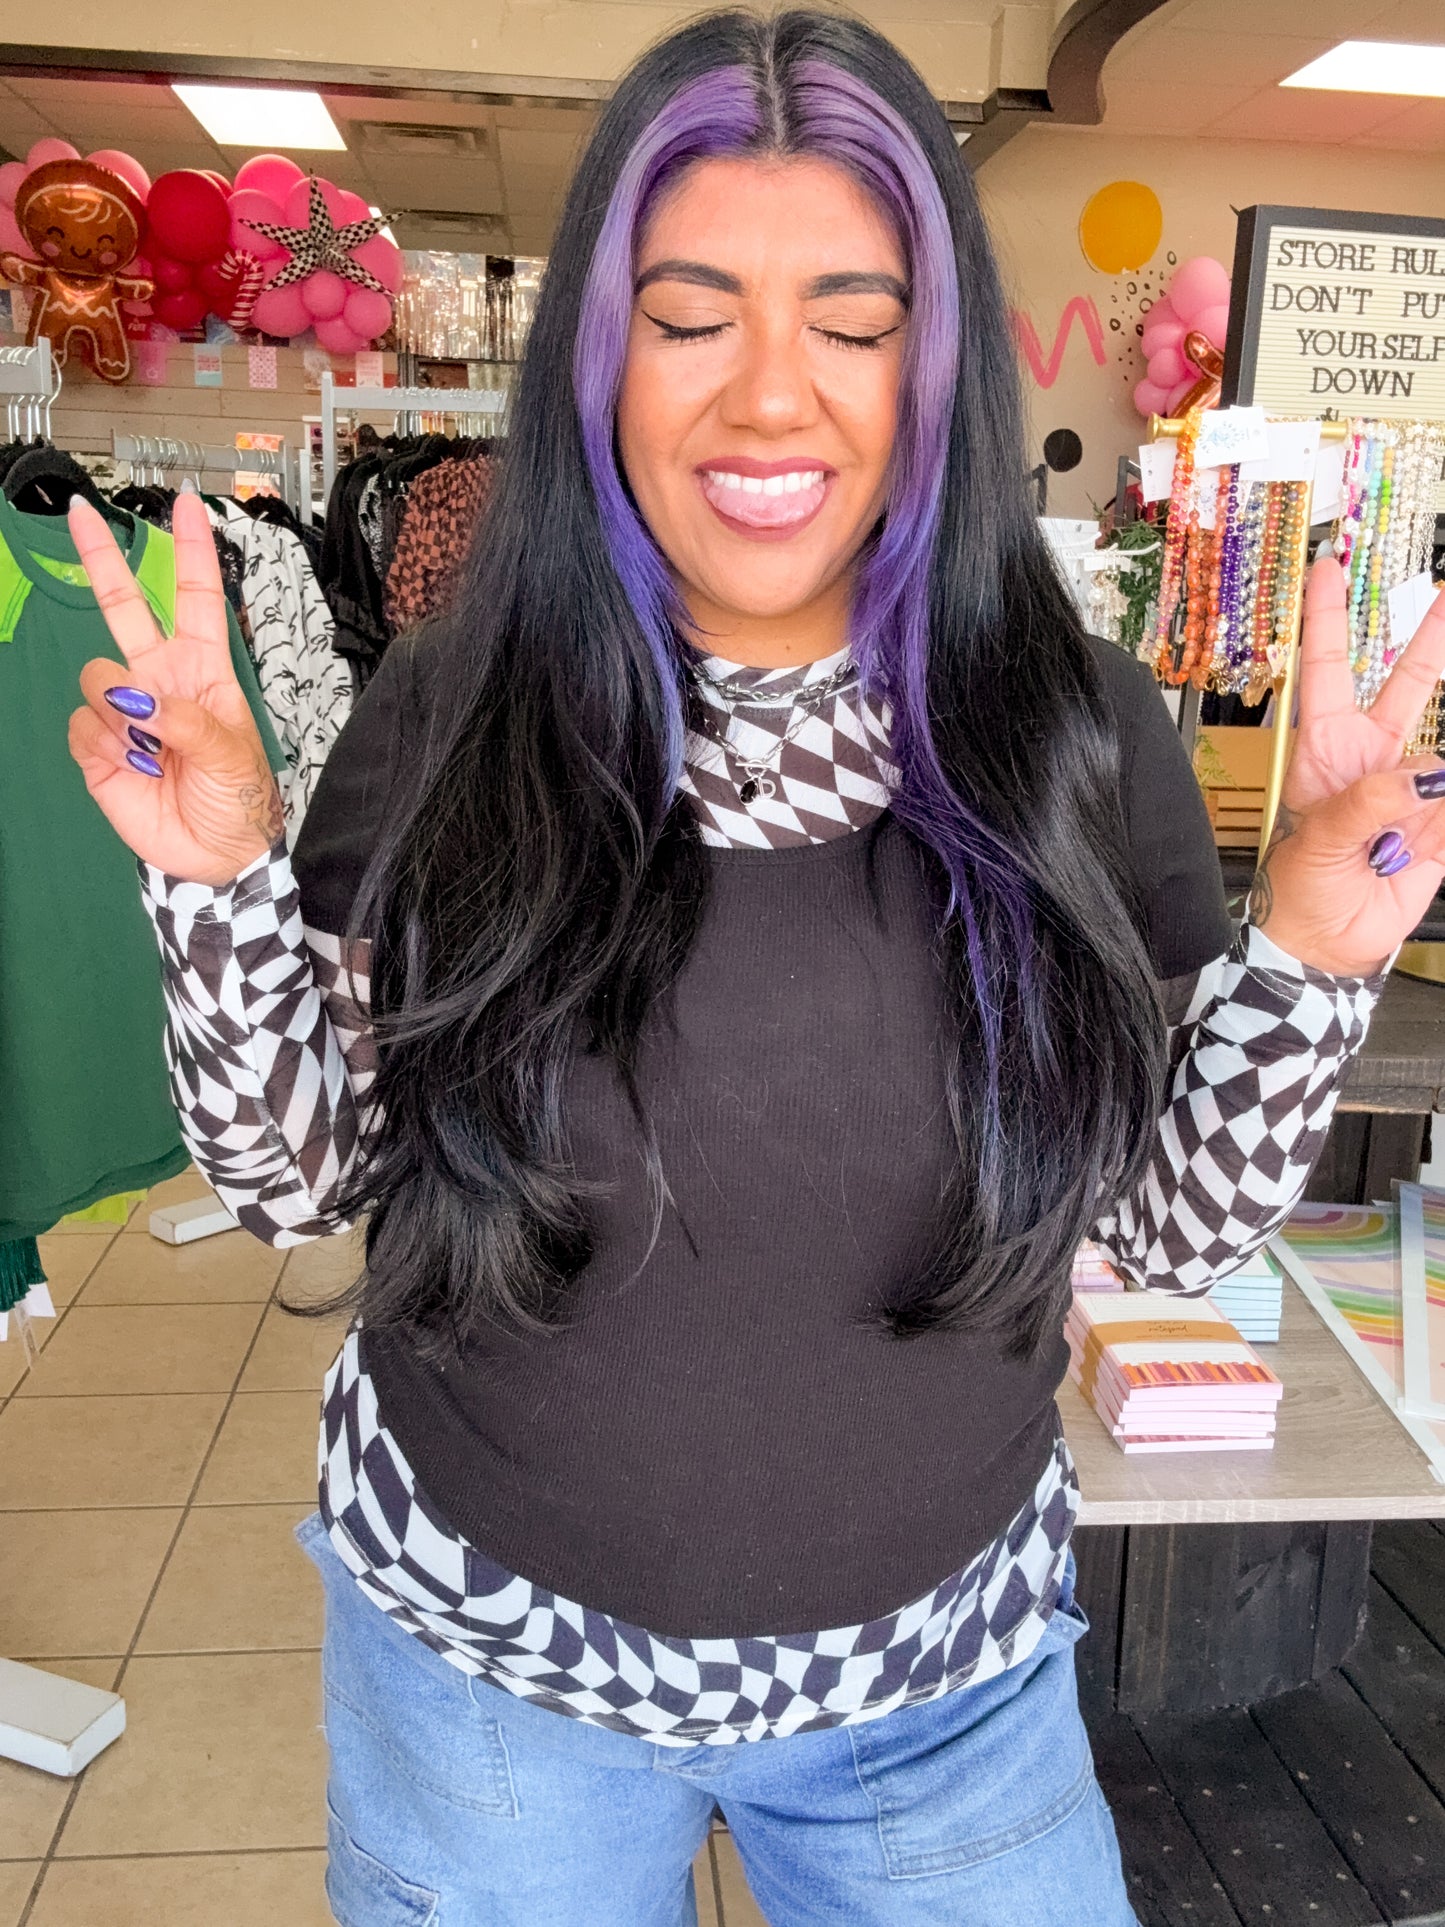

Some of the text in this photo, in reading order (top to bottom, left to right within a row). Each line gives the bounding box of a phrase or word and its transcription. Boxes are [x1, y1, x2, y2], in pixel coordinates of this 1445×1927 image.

[1277, 239, 1376, 271] STORE
[1269, 284, 1445, 319] DON'T PU
[1297, 329, 1445, 361] YOURSELF
[1310, 367, 1415, 397] DOWN
